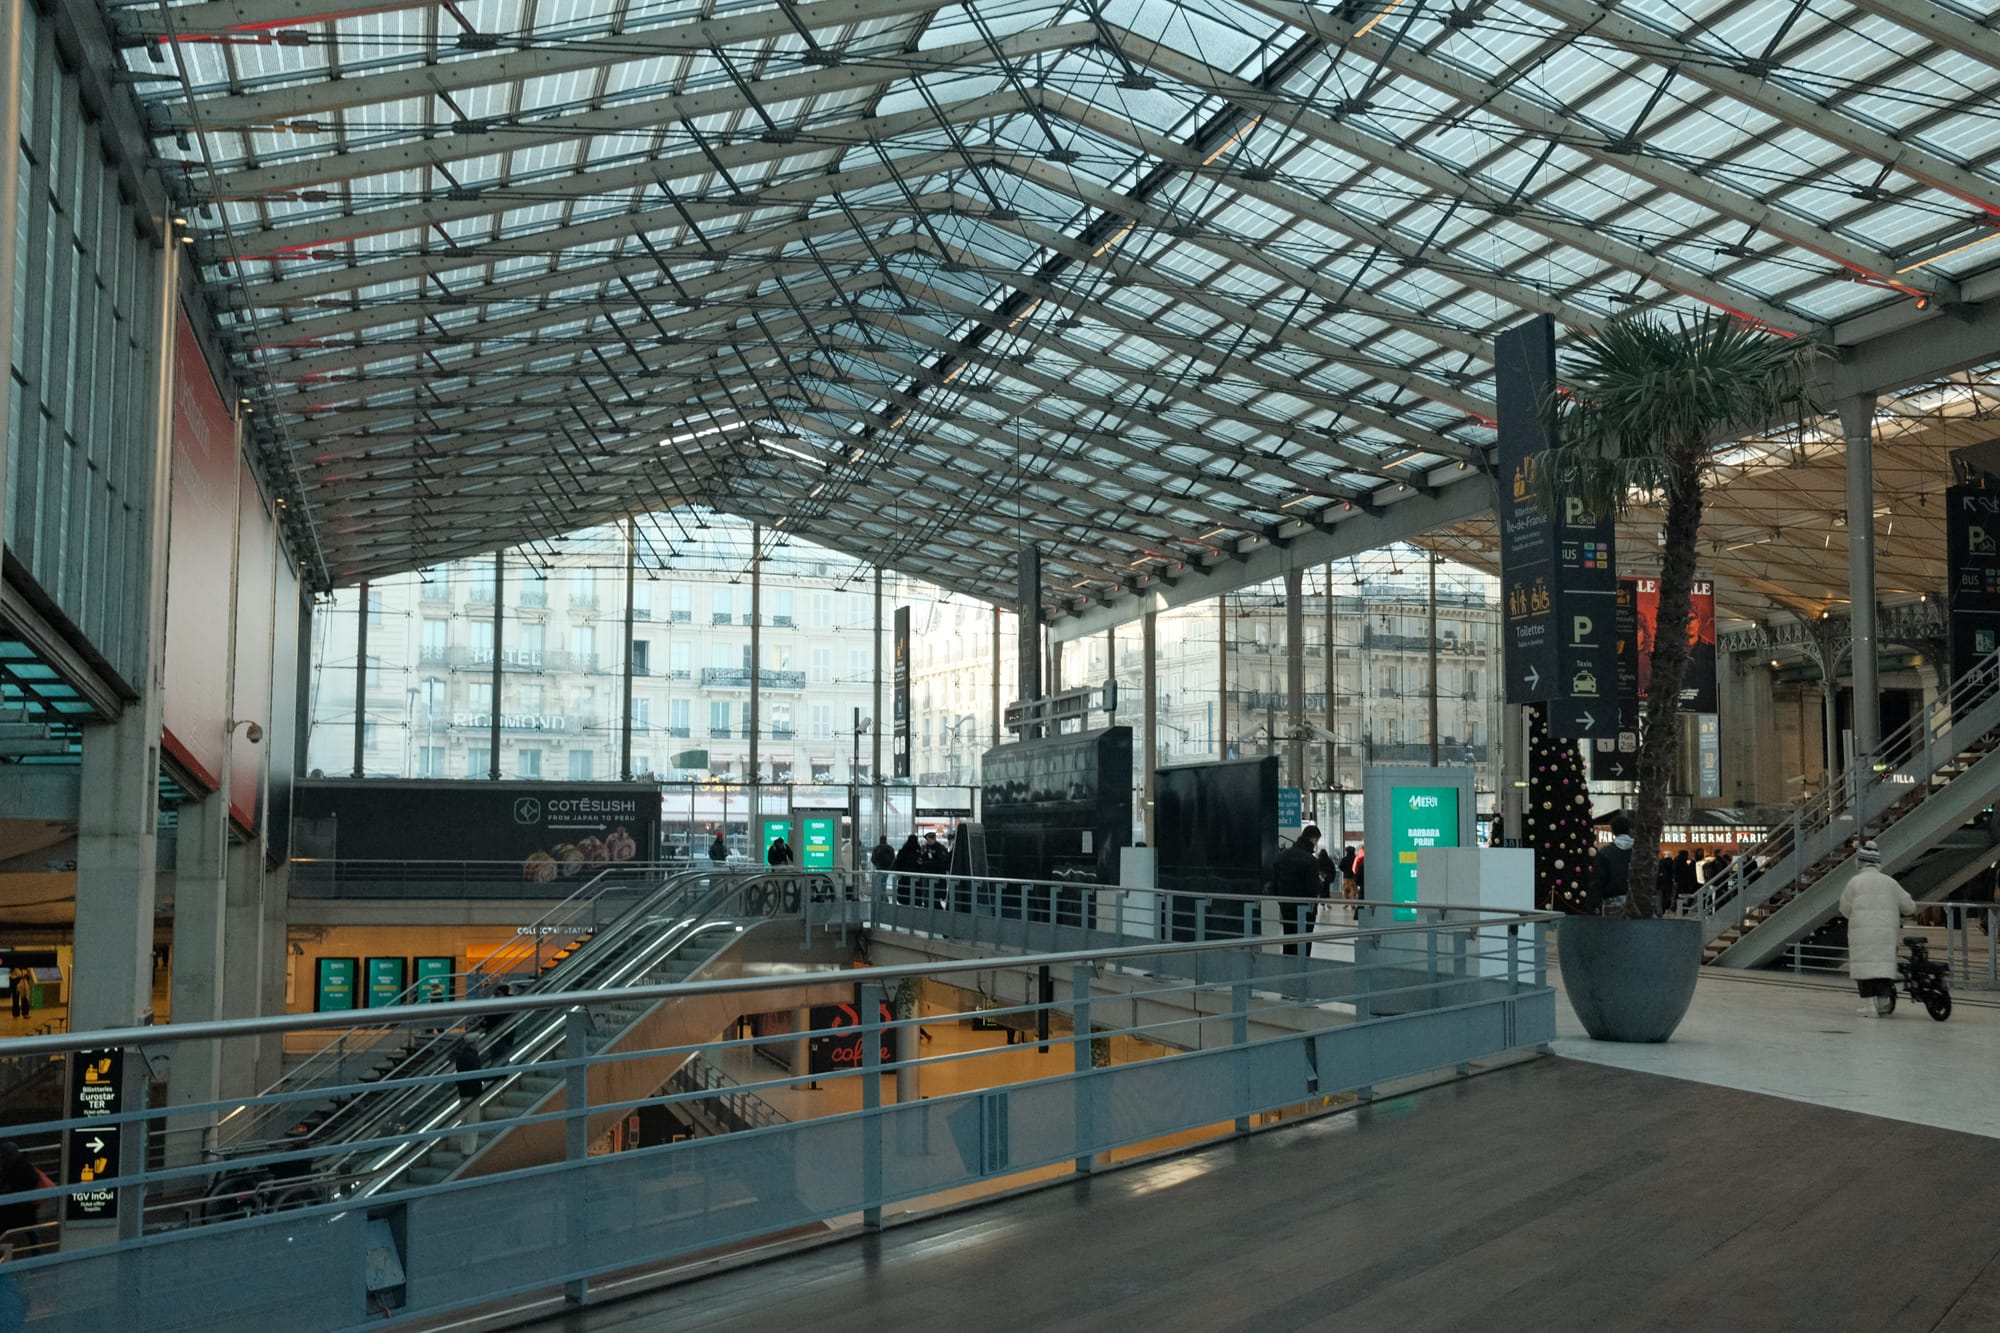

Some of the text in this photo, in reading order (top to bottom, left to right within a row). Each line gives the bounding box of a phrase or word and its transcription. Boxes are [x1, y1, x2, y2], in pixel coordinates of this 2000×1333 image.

[1968, 525, 1985, 551] P
[1961, 574, 1979, 585] BUS
[1516, 624, 1545, 638] Toilettes
[1573, 615, 1593, 643] P
[1576, 660, 1592, 668] Taxis
[1598, 832, 1616, 843] PAR
[1660, 829, 1768, 843] RRE HERMÉ PARIS
[80, 1092, 115, 1101] Eurostar
[89, 1100, 106, 1109] TER
[72, 1192, 90, 1201] TGV
